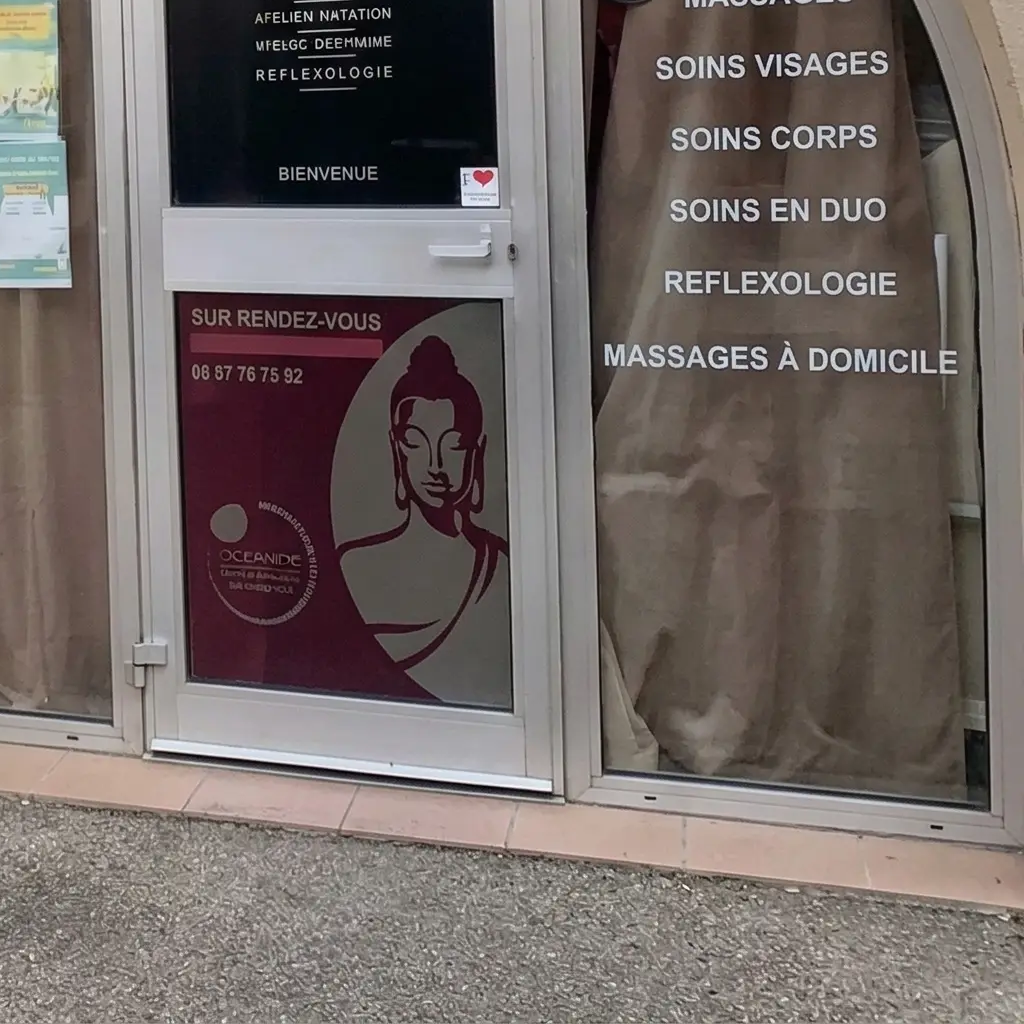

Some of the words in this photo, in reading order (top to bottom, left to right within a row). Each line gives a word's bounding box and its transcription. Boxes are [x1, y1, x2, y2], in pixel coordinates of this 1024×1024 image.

[256, 66, 393, 81] REFLEXOLOGIE
[656, 54, 745, 80] SOINS
[754, 51, 888, 77] VISAGES
[671, 126, 761, 152] SOINS
[771, 125, 877, 149] CORPS
[279, 166, 378, 181] BIENVENUE
[670, 198, 760, 222] SOINS
[771, 198, 809, 222] EN
[821, 198, 886, 222] DUO
[665, 271, 897, 296] REFLEXOLOGIE
[192, 308, 232, 327] SUR
[238, 309, 381, 331] RENDEZ-VOUS
[604, 344, 768, 370] MASSAGES
[778, 341, 799, 371] À
[809, 347, 958, 374] DOMICILE
[237, 366, 256, 382] 76
[260, 366, 279, 383] 75
[284, 367, 303, 384] 92
[220, 549, 301, 567] OCEANIDE
